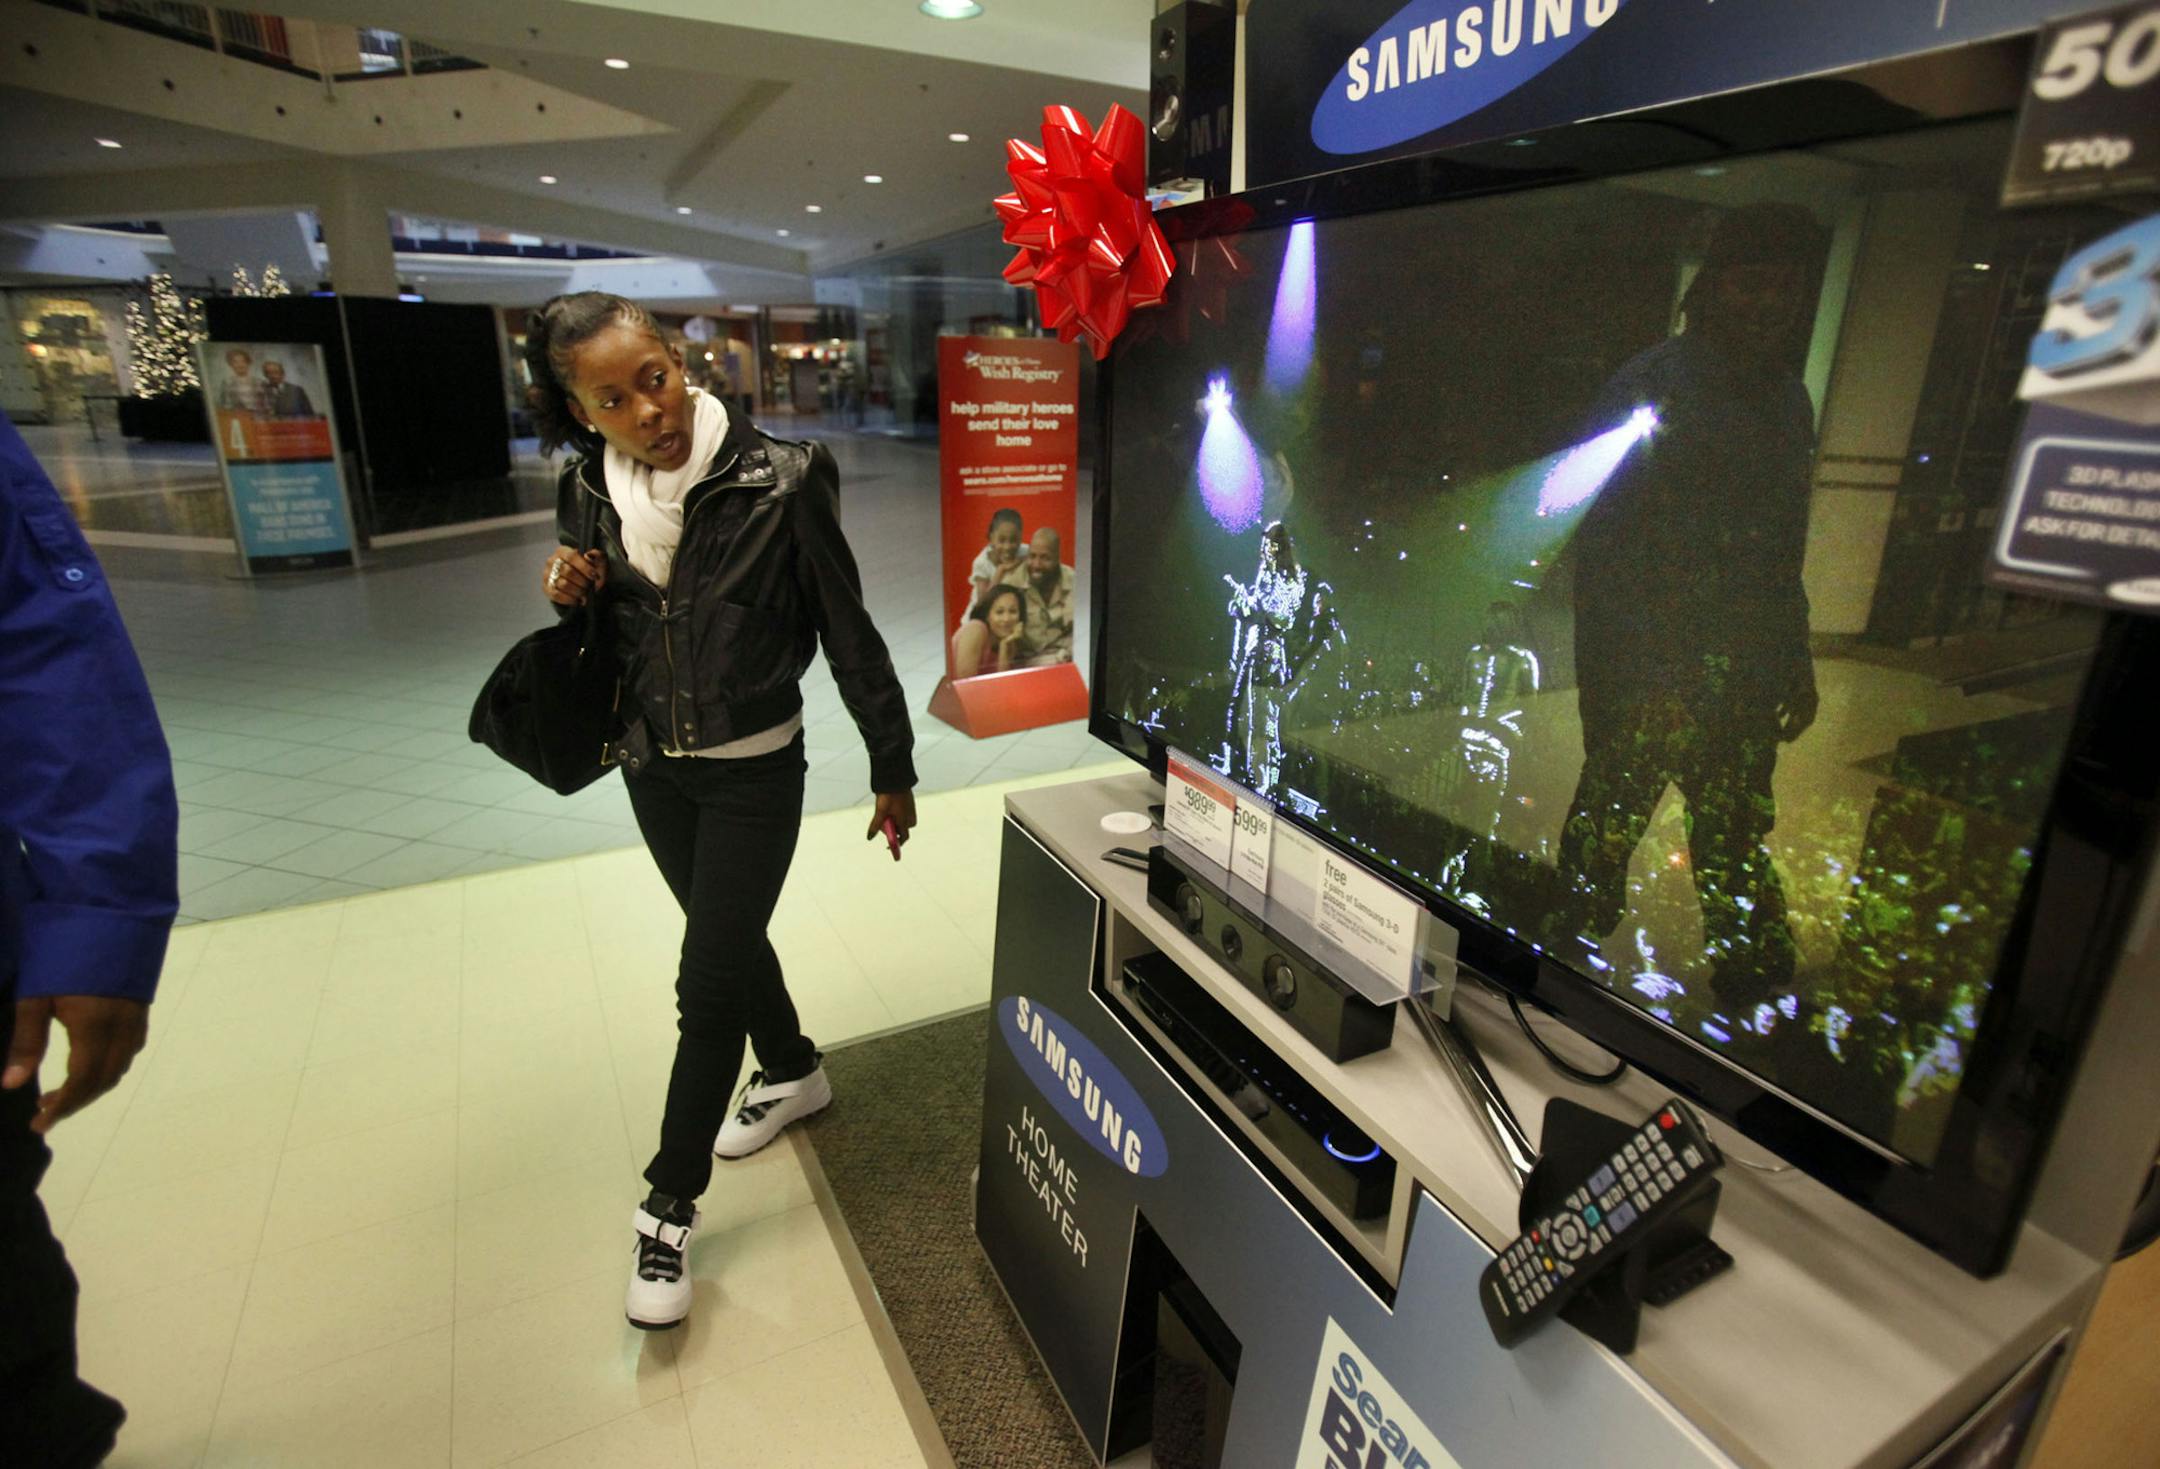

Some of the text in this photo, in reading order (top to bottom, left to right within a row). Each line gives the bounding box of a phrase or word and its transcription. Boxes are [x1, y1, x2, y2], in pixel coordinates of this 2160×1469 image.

[2033, 10, 2160, 99] 50
[2043, 136, 2134, 172] 720p
[980, 366, 1060, 383] Wish Registry
[951, 402, 1075, 416] help military heroes
[968, 418, 1060, 431] send their love
[996, 434, 1032, 446] home
[2068, 465, 2098, 484] 3D
[2024, 516, 2064, 535] ASK
[2066, 520, 2106, 541] FOR
[1325, 859, 1347, 886] free
[1016, 995, 1142, 1175] SAMSUNG
[1022, 1106, 1078, 1205] HOME
[1007, 1123, 1088, 1268] THEATER
